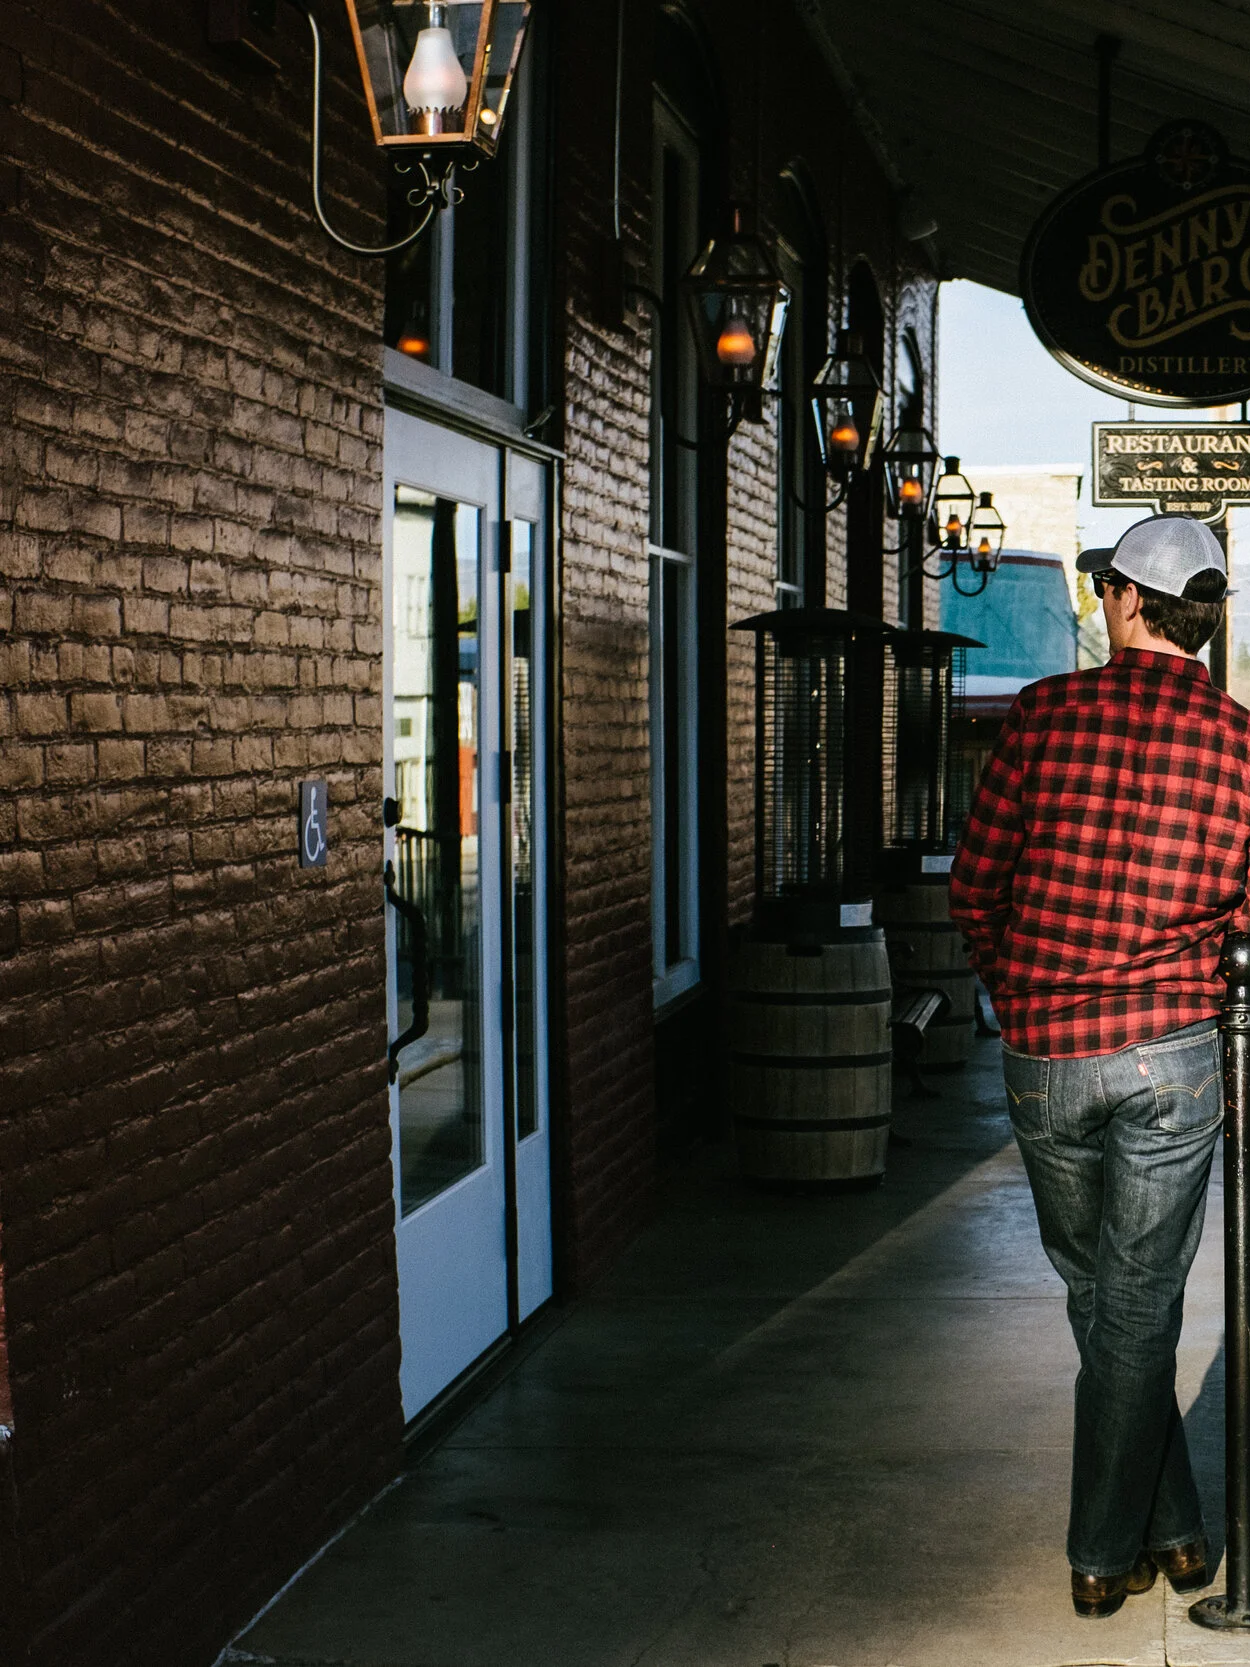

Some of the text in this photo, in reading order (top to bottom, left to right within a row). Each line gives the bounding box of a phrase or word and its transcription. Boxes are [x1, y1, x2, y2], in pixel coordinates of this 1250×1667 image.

[1079, 200, 1250, 302] DENNY
[1137, 256, 1231, 337] BAR
[1119, 477, 1199, 492] TASTING
[1180, 456, 1199, 473] &
